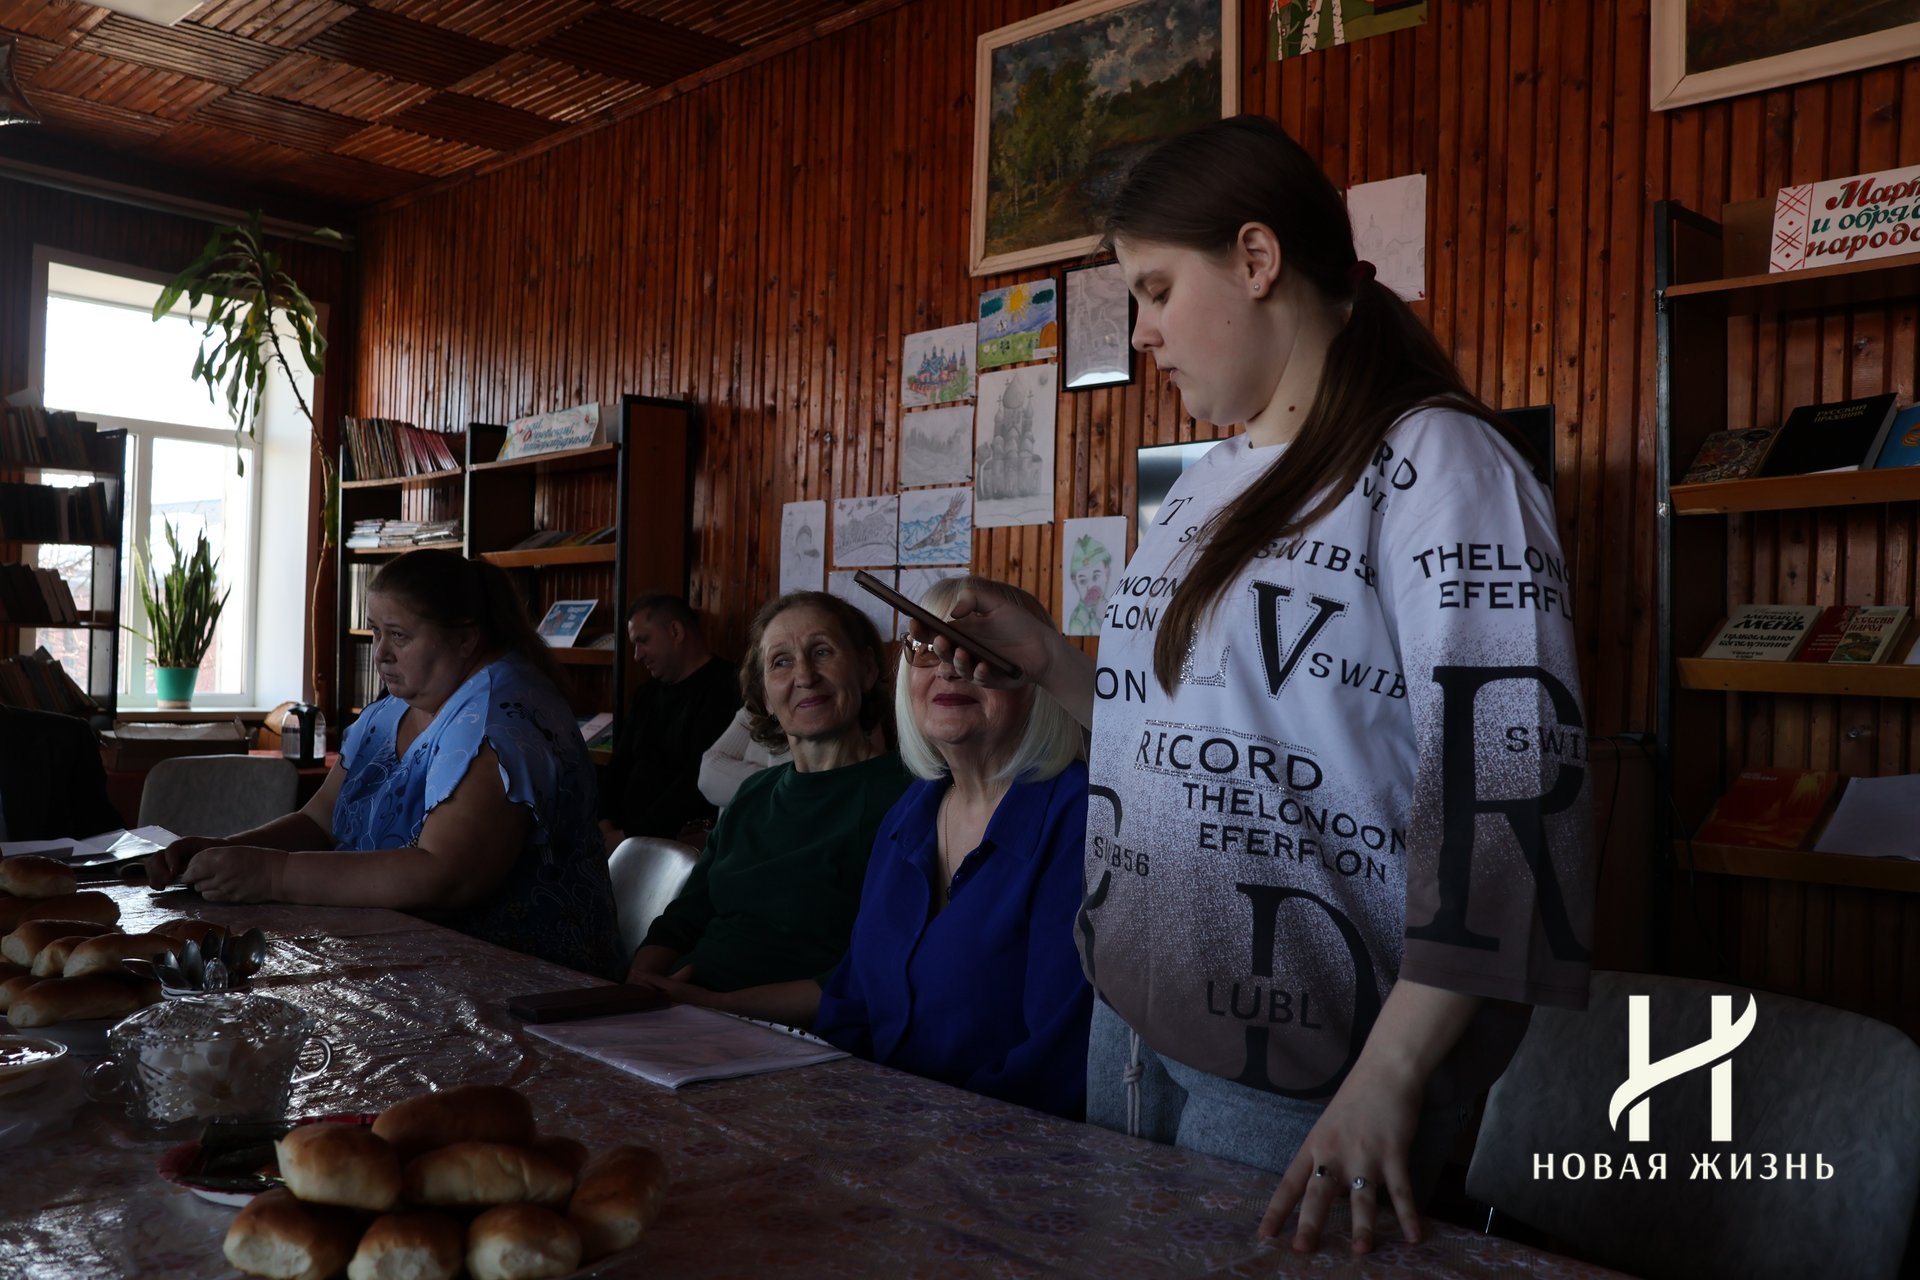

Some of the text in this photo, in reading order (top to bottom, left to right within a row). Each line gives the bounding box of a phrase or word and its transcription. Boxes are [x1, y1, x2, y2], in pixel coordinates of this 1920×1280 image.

[1812, 218, 1831, 234] и
[1136, 730, 1323, 791] RECORD
[1506, 726, 1588, 761] SWI
[1182, 782, 1407, 855] THELONOON
[1199, 822, 1387, 885] EFERFLON
[1206, 980, 1322, 1030] LUBL
